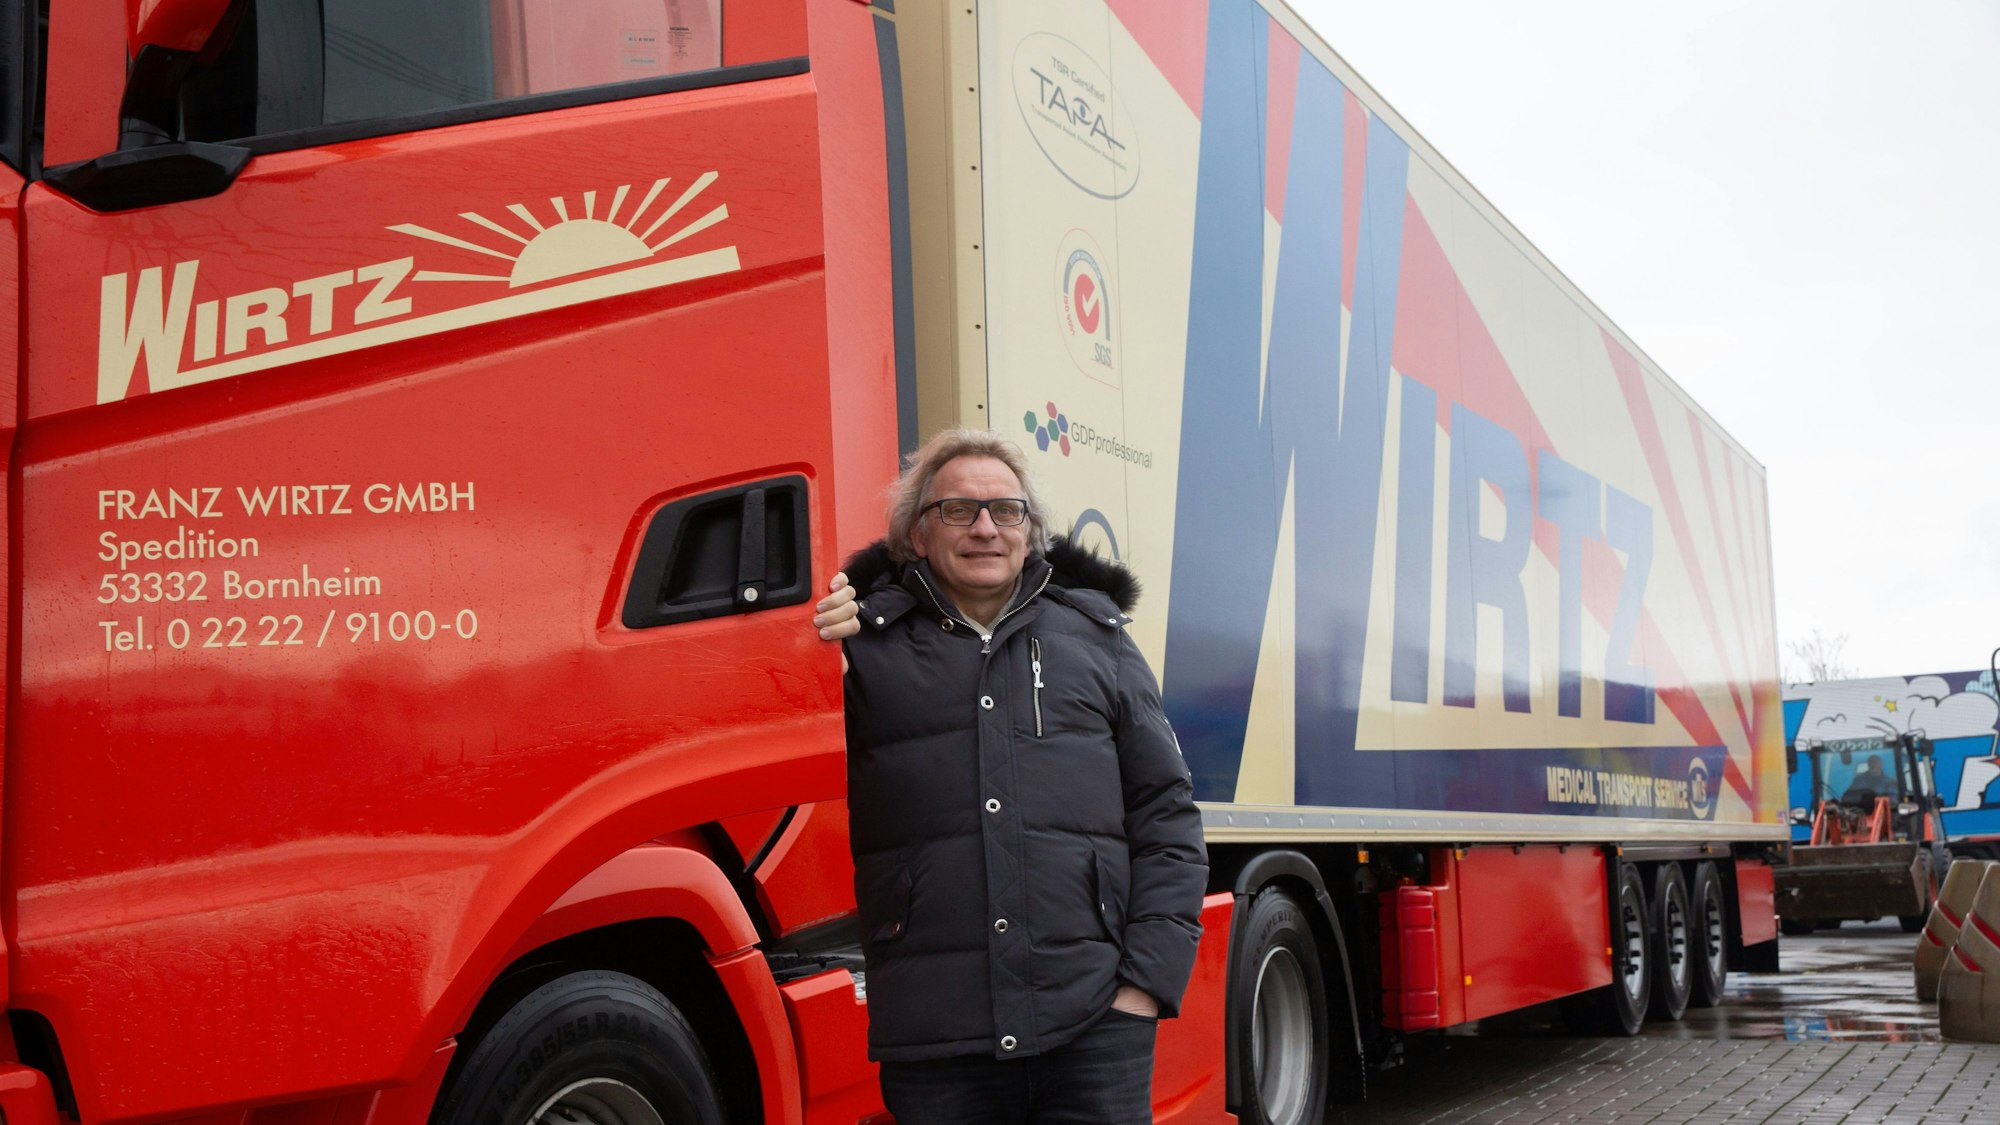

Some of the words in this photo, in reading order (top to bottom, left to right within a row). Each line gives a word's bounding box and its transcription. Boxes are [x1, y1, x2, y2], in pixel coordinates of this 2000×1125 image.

[1051, 55, 1070, 78] TSR
[1029, 66, 1126, 151] TAPA
[97, 256, 414, 405] WIRTZ
[1094, 342, 1112, 367] SGS
[1162, 0, 1656, 808] WIRTZ
[98, 488, 224, 520] FRANZ
[236, 485, 353, 517] WIRTZ
[363, 482, 475, 514] GMBH
[98, 526, 260, 571] Spedition
[97, 571, 208, 604] 53332
[223, 563, 382, 600] Bornheim
[98, 616, 154, 652] Tel.
[345, 609, 479, 644] 9100-0
[1546, 766, 1597, 804] MEDICAL
[1597, 771, 1652, 807] TRANSPORT
[1654, 777, 1689, 809] SERVICE
[516, 1015, 591, 1085] 385/55
